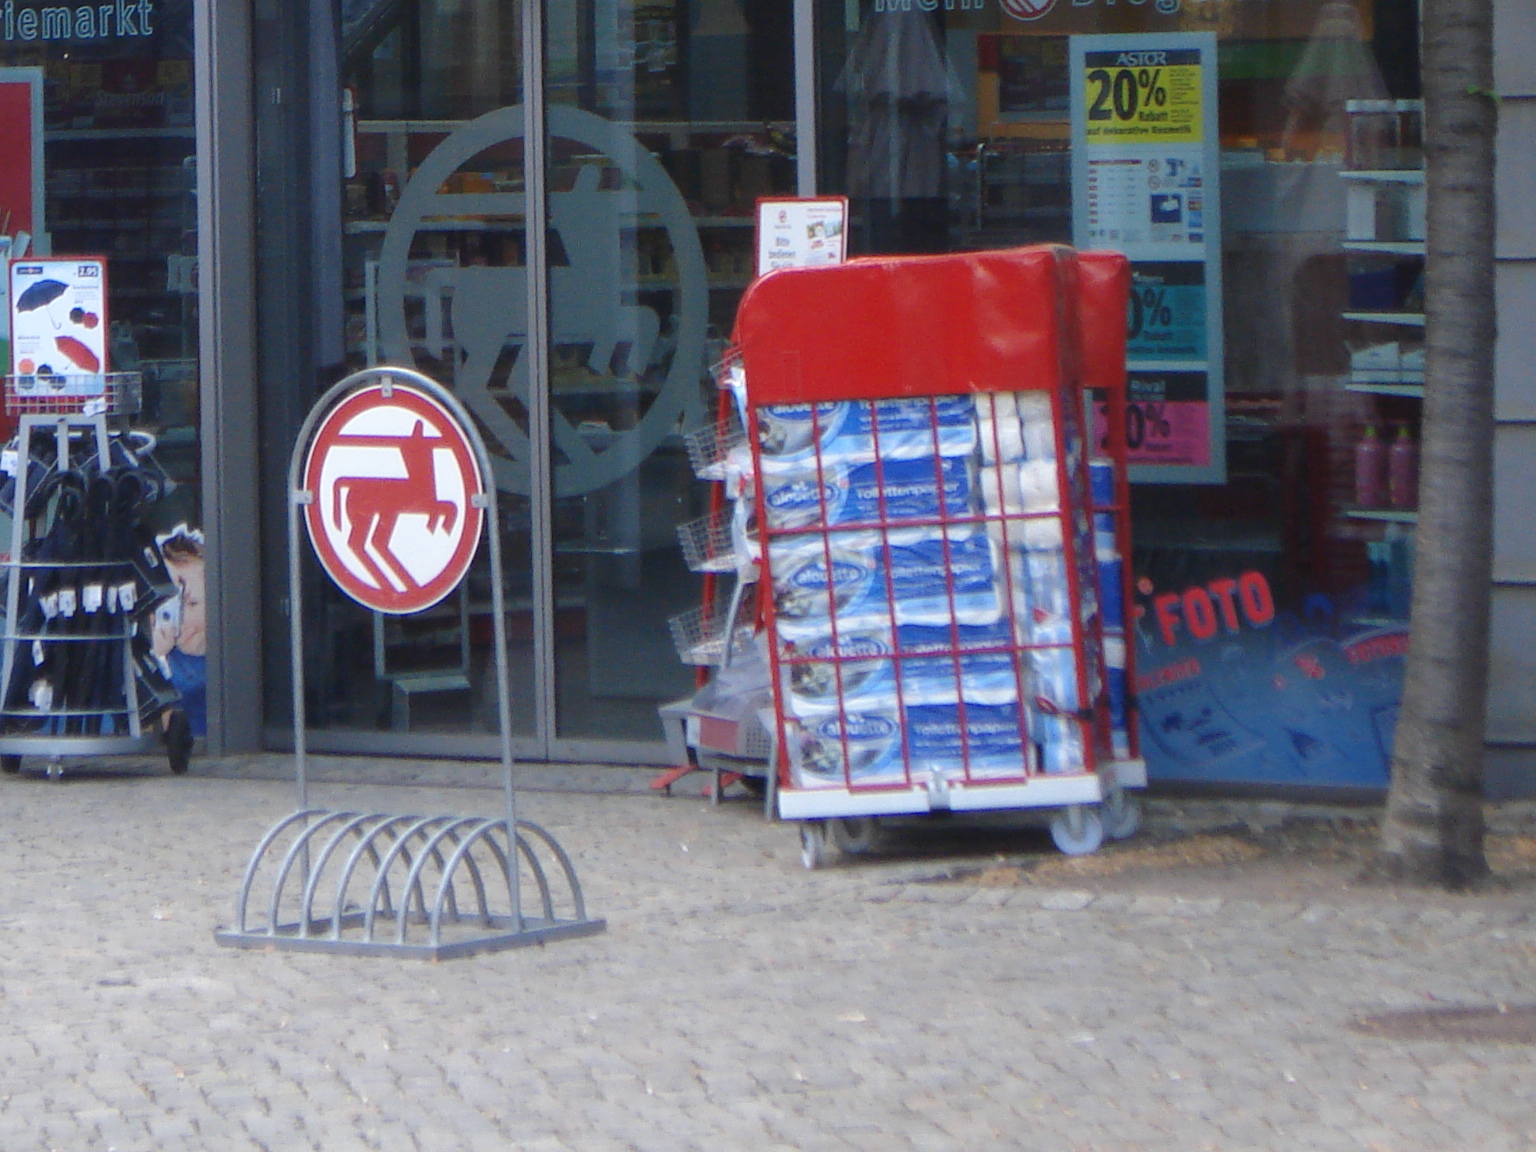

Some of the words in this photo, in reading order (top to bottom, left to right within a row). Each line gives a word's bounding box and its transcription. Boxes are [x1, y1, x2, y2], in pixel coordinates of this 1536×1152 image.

[1115, 51, 1167, 67] ASTOR
[1087, 68, 1167, 122] 20%
[1154, 570, 1275, 647] FOTO
